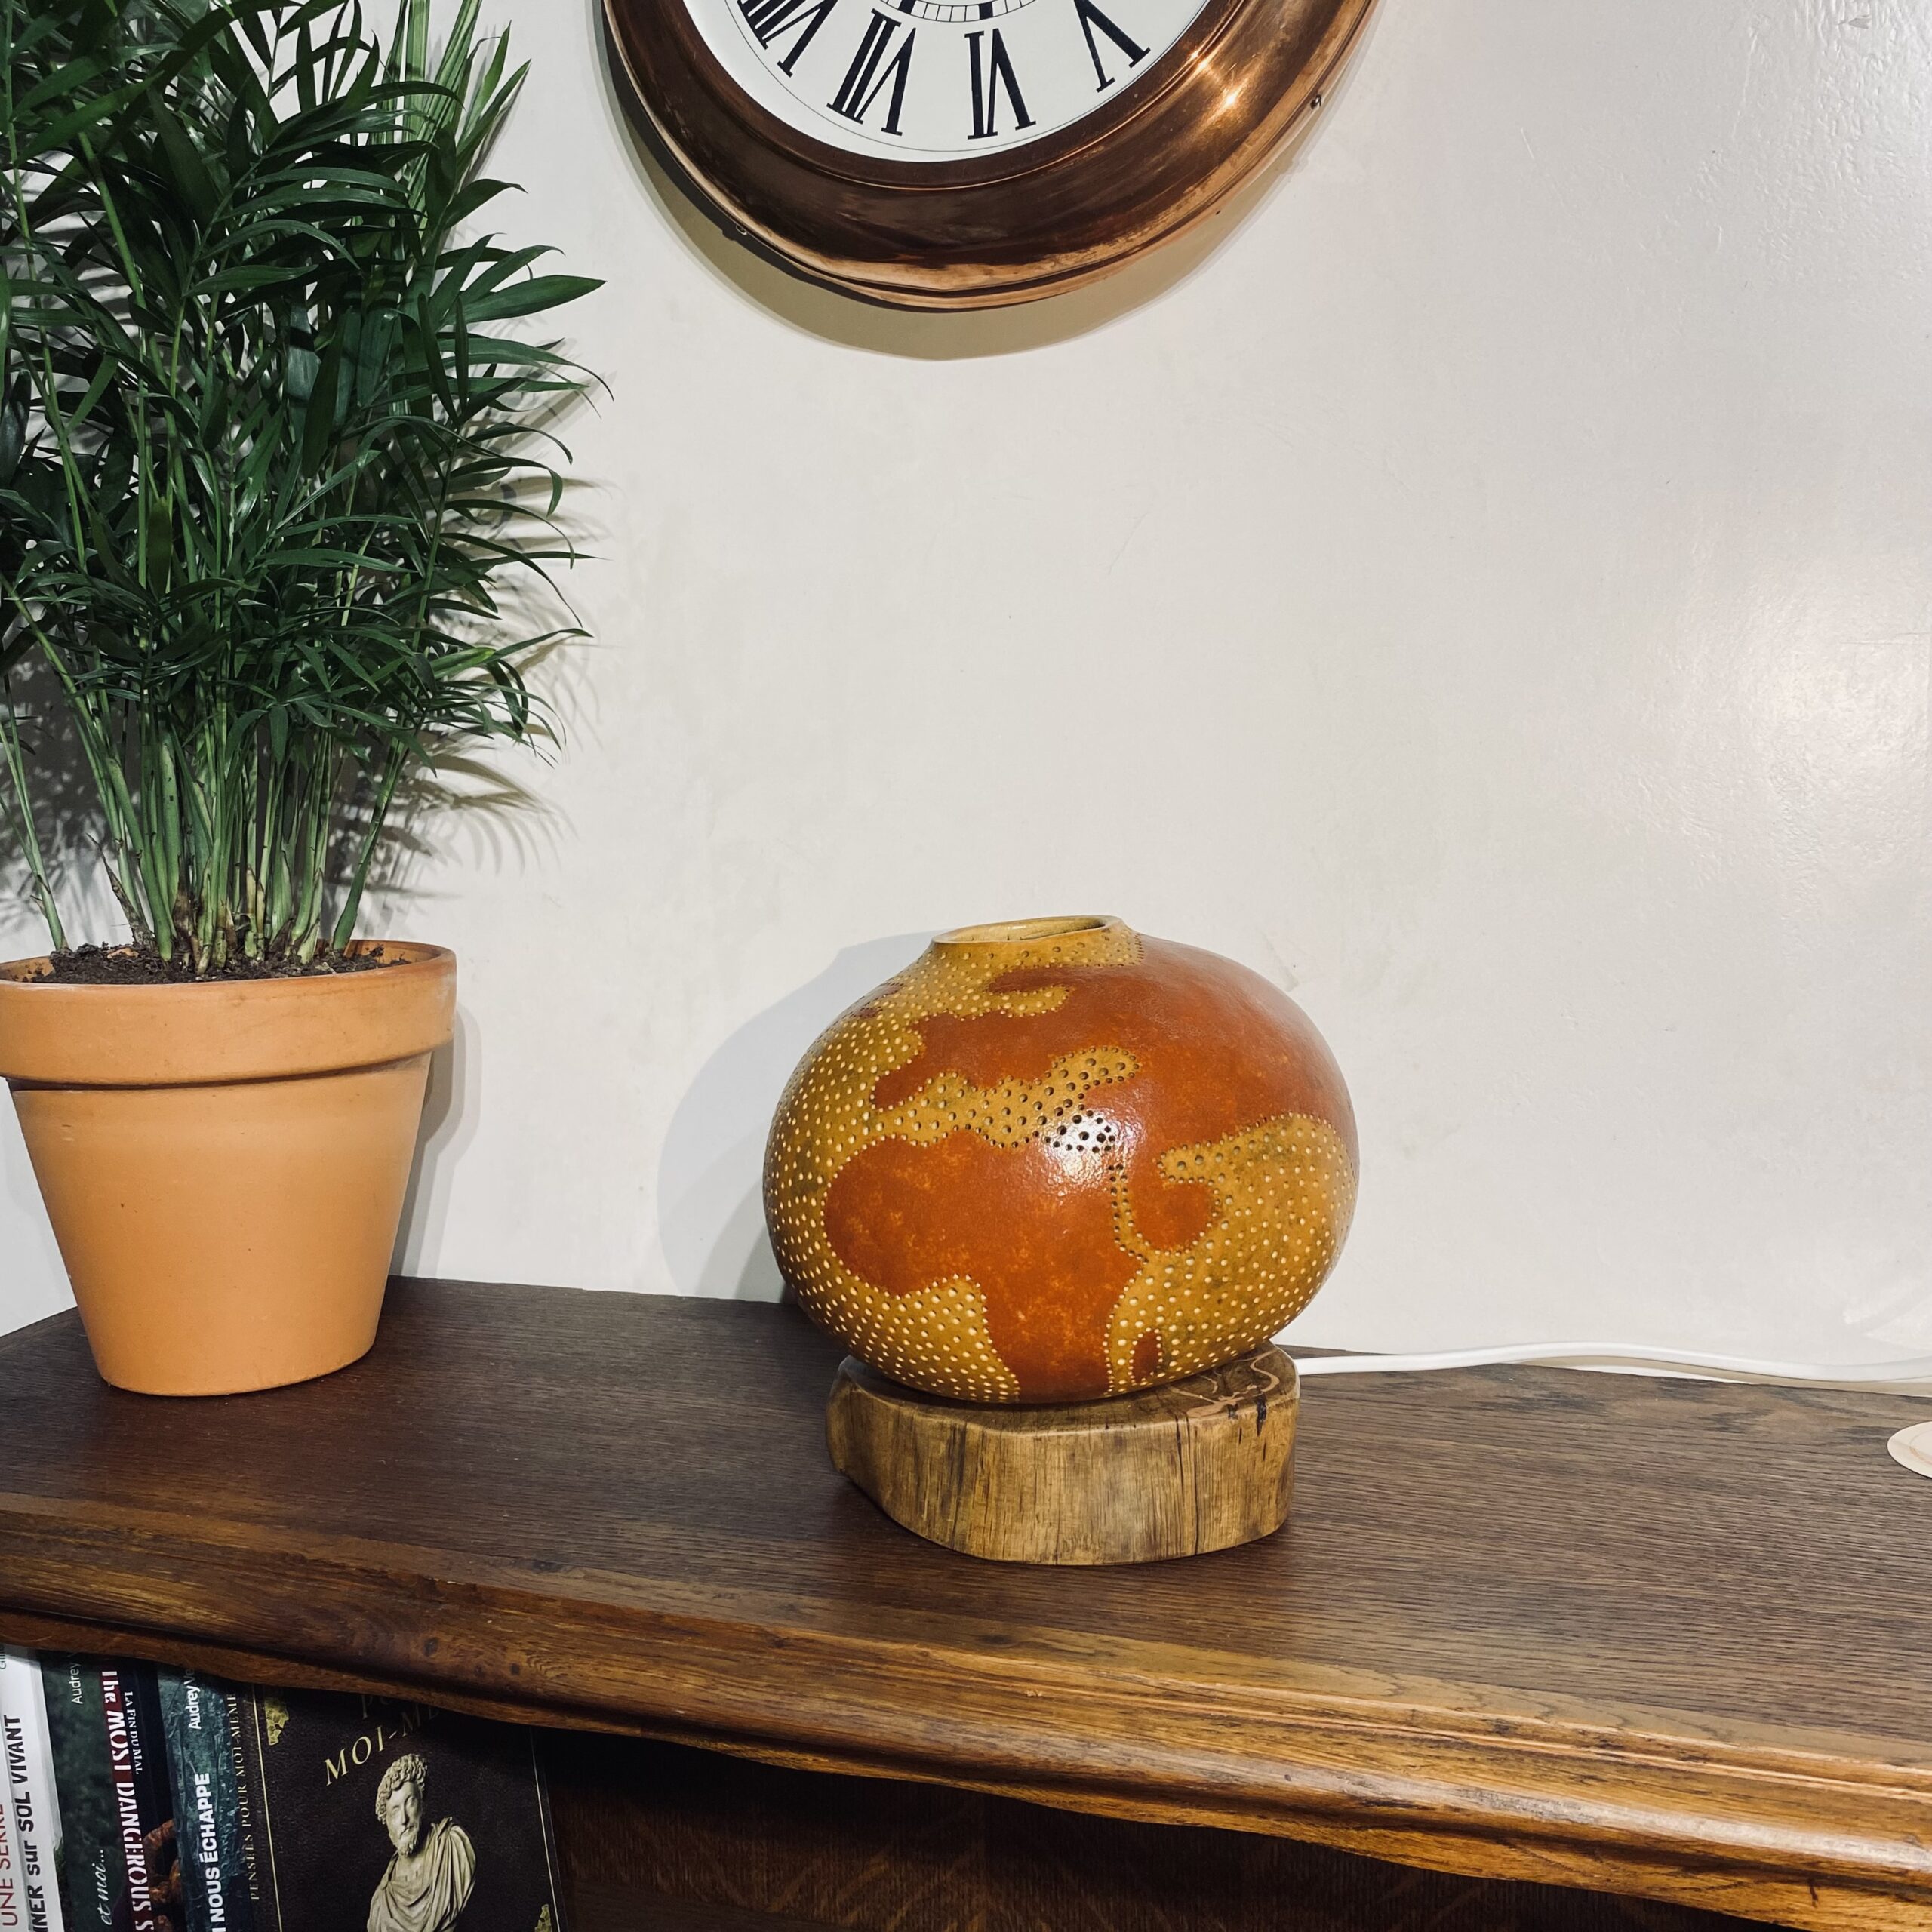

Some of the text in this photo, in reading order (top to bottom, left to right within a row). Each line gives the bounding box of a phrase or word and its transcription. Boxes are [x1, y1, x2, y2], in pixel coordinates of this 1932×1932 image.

[826, 8, 916, 137] VII
[1074, 0, 1152, 93] V
[964, 28, 1037, 140] VI
[69, 1663, 83, 1705] Audrey
[185, 1685, 202, 1730] Audrey
[4, 1714, 28, 1784] VIVANT
[106, 1710, 131, 1770] MOST
[14, 1792, 34, 1832] SOL
[195, 1773, 219, 1863] ÉCHAPPE
[238, 1785, 251, 1827] POUR
[24, 1840, 41, 1875] sur
[116, 1782, 152, 1912] DANGEROUS
[0, 1878, 18, 1926] UNE
[97, 1903, 112, 1925] et
[205, 1866, 226, 1922] NOUS
